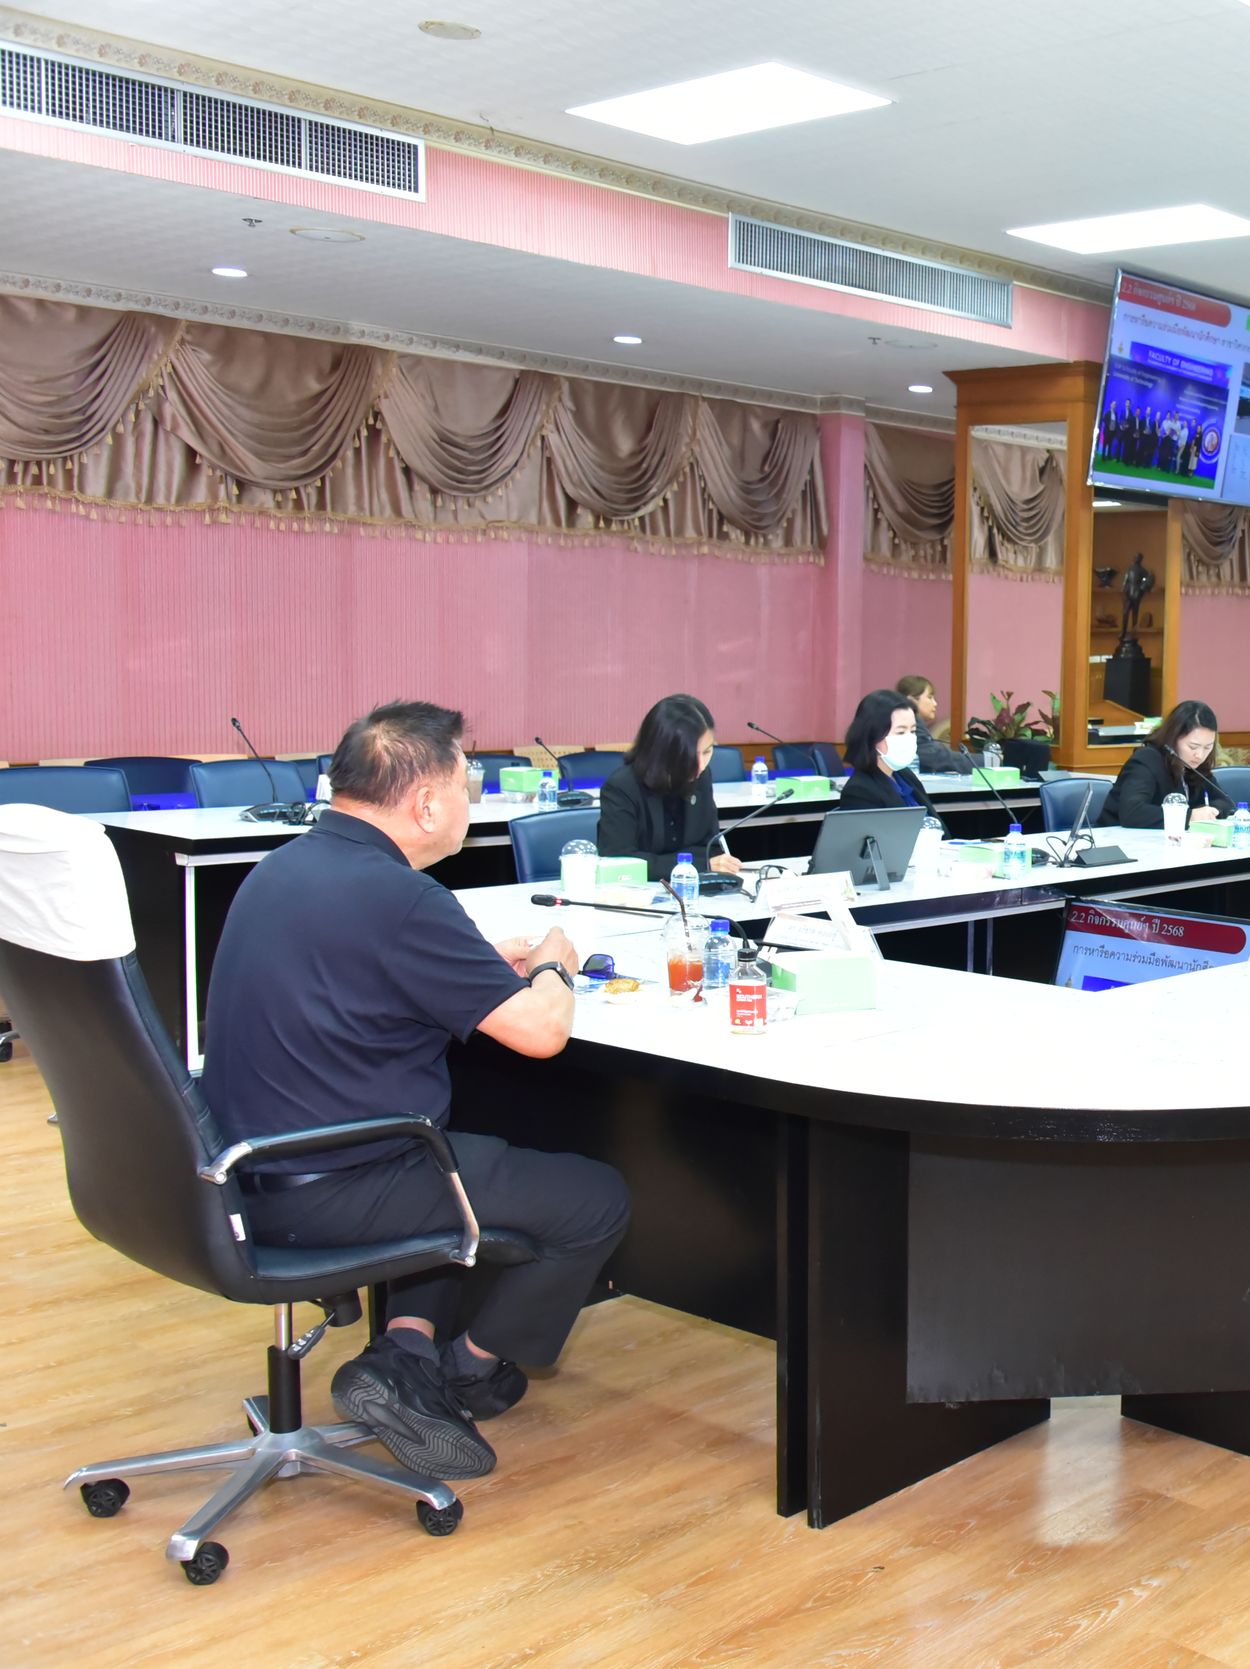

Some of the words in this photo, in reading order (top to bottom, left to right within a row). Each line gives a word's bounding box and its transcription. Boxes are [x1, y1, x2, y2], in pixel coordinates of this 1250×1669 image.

[1071, 911, 1085, 923] 2.2
[1152, 918, 1161, 934] ปี
[1161, 923, 1185, 937] 2568
